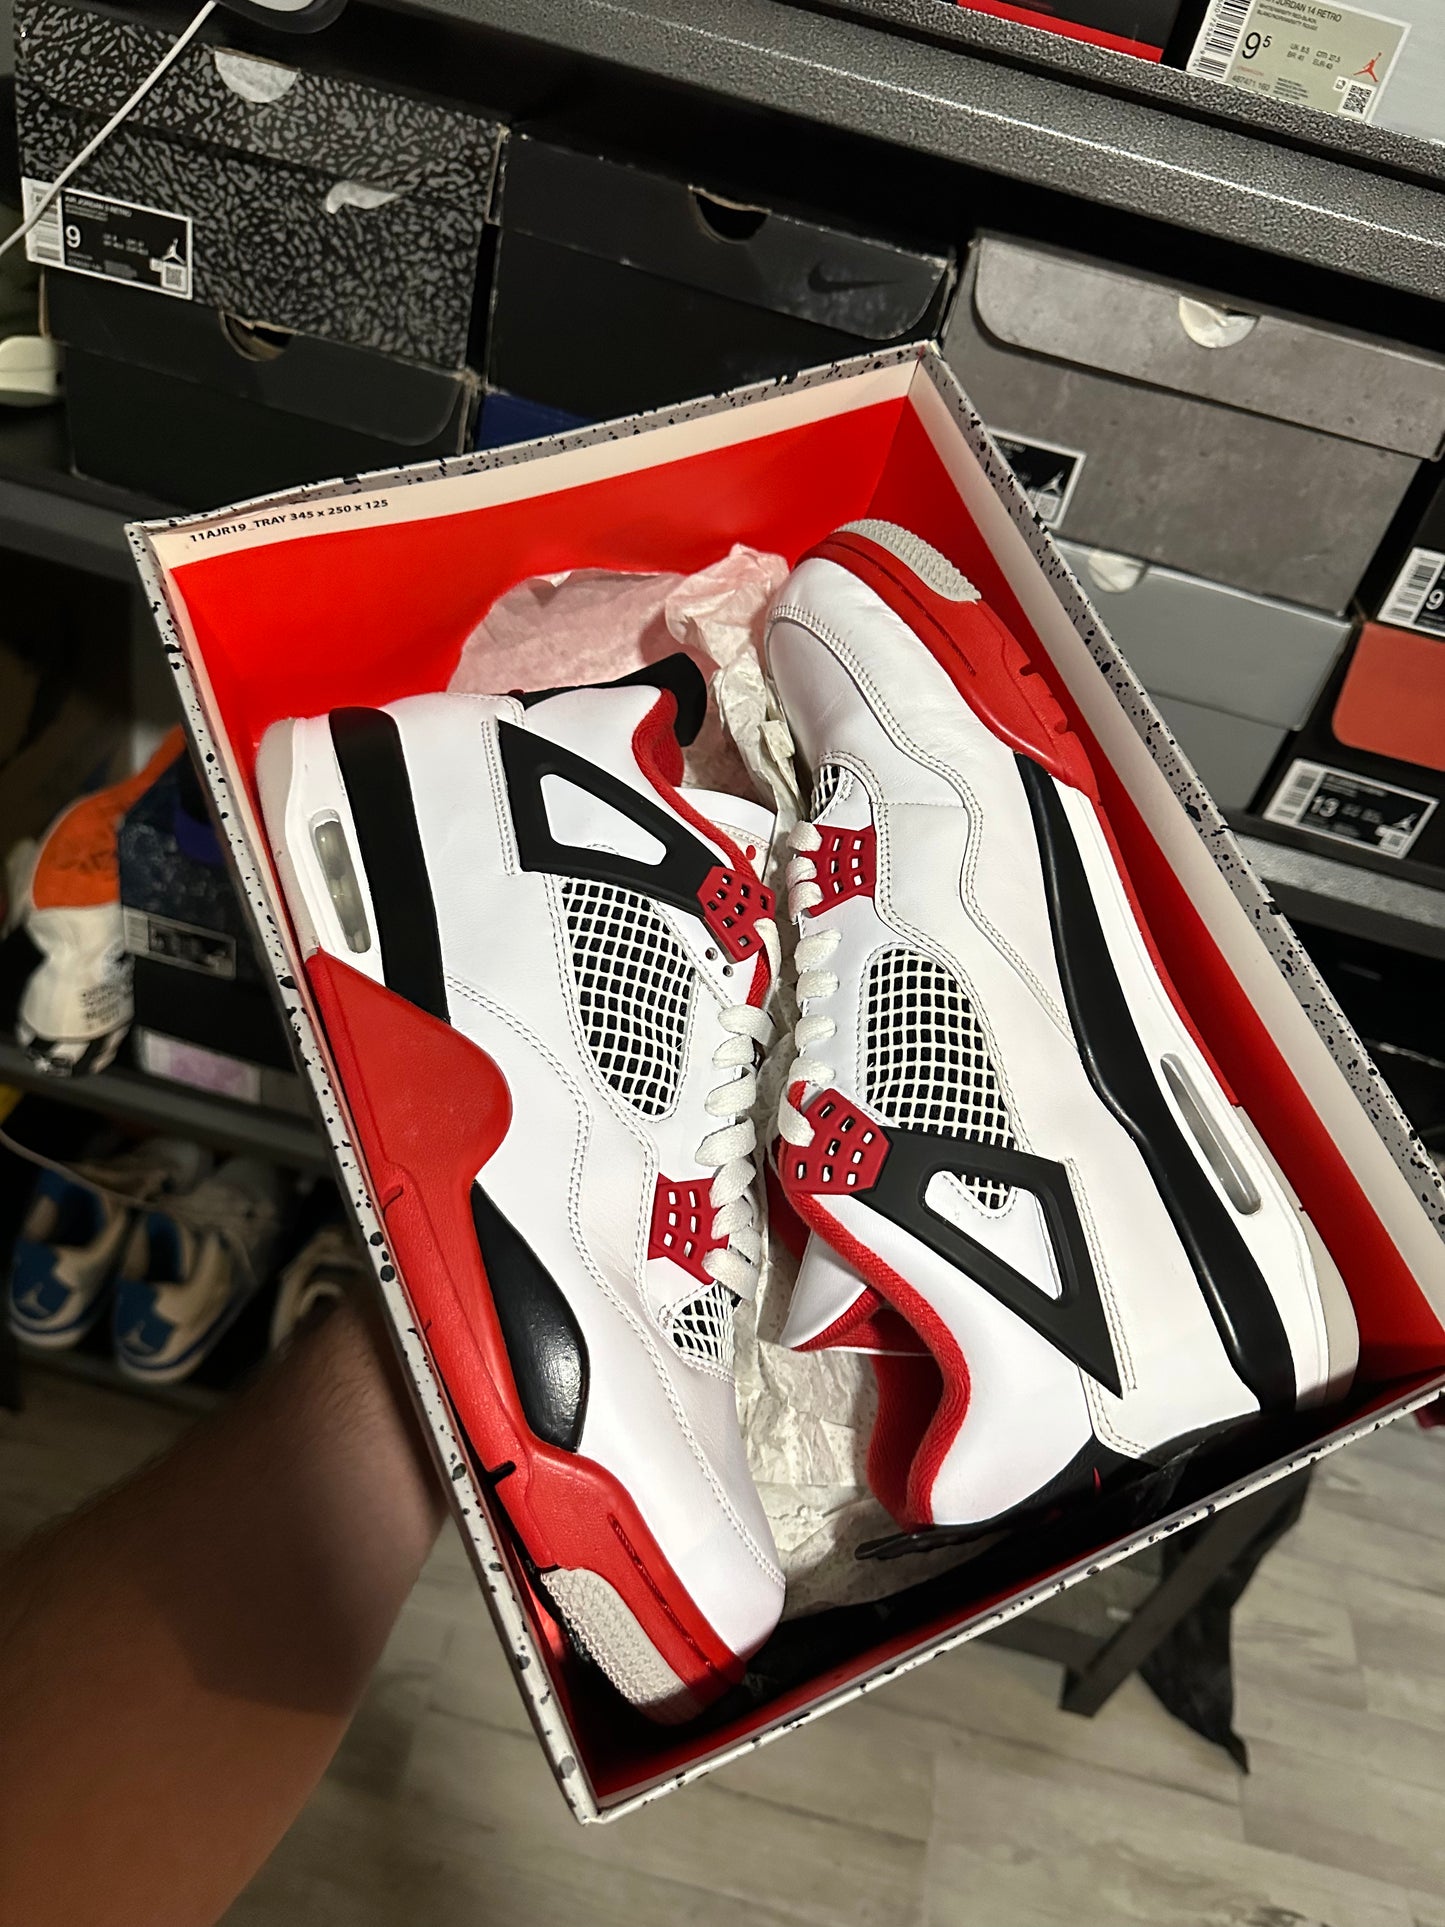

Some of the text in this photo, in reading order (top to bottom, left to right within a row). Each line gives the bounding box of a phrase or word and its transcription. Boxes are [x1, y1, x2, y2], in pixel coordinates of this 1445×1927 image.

[1307, 6, 1316, 15] 14
[1317, 8, 1342, 22] RETRO
[65, 224, 81, 249] 9
[290, 511, 314, 521] 345
[328, 504, 351, 515] 250
[366, 499, 389, 509] 125
